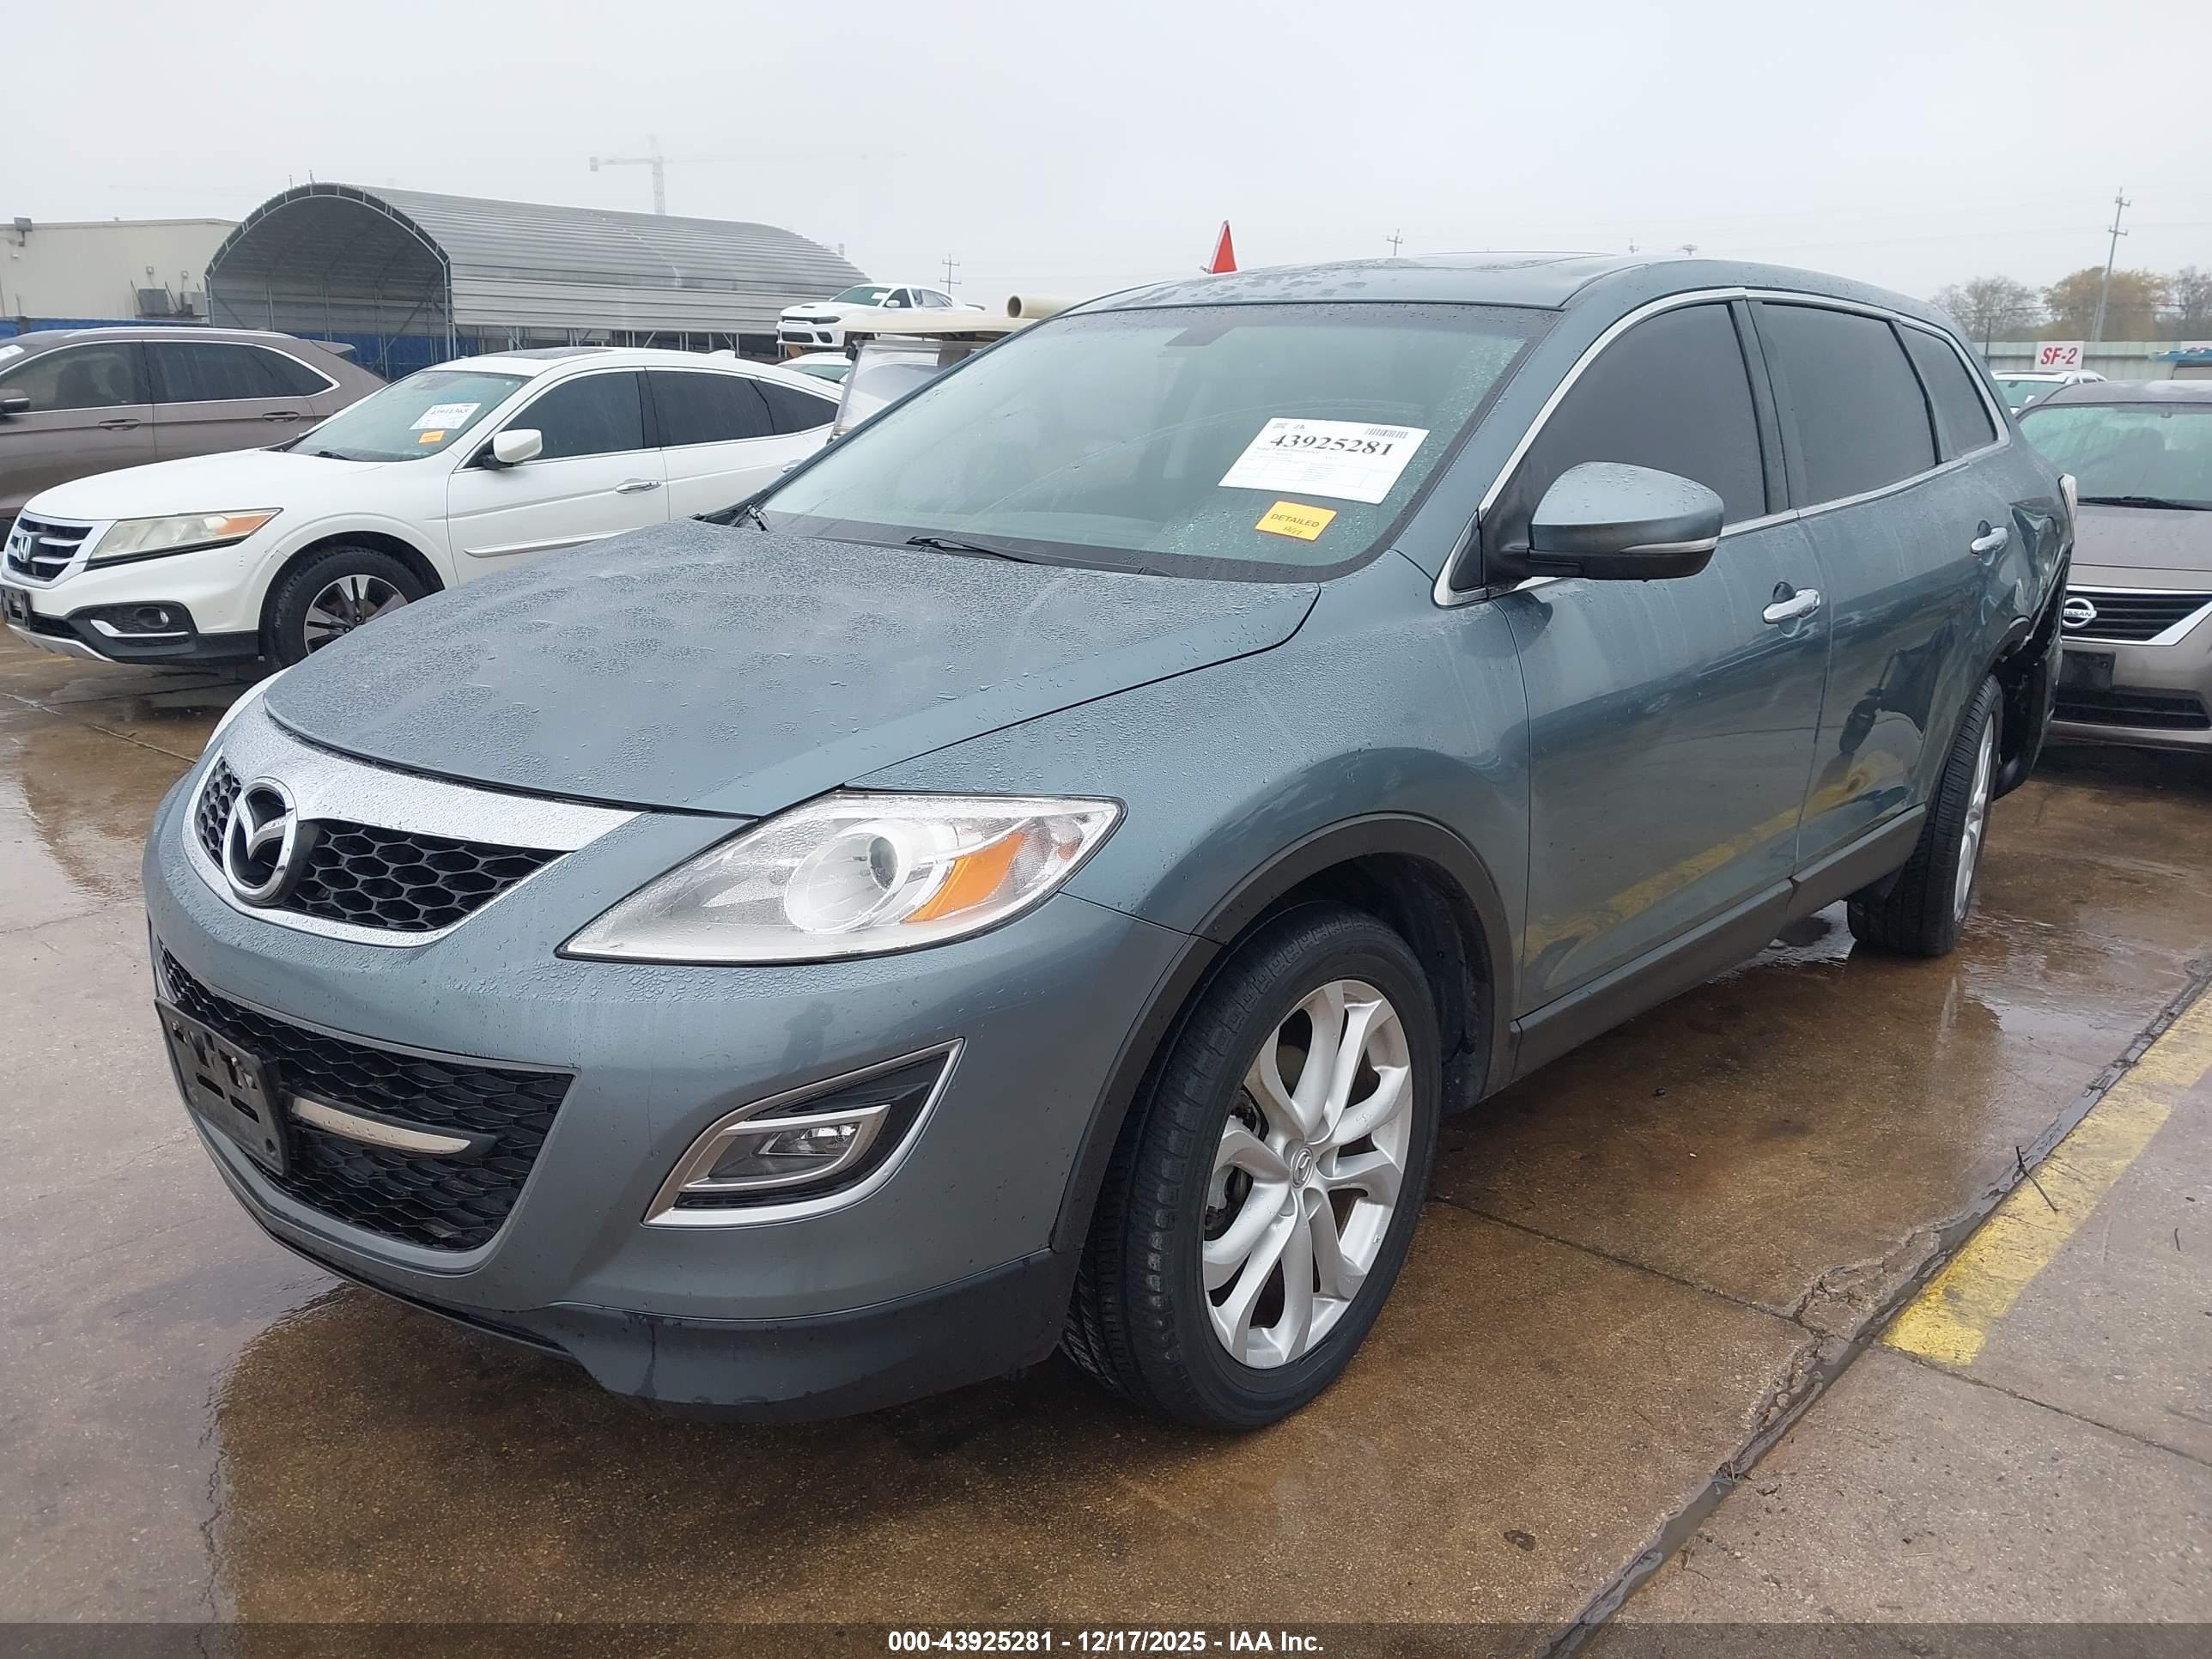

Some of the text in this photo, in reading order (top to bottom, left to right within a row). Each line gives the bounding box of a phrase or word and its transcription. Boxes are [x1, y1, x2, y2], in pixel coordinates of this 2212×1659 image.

[2040, 347, 2077, 365] SF-2
[1269, 434, 1394, 456] 43925281
[1270, 514, 1320, 527] DETAILED
